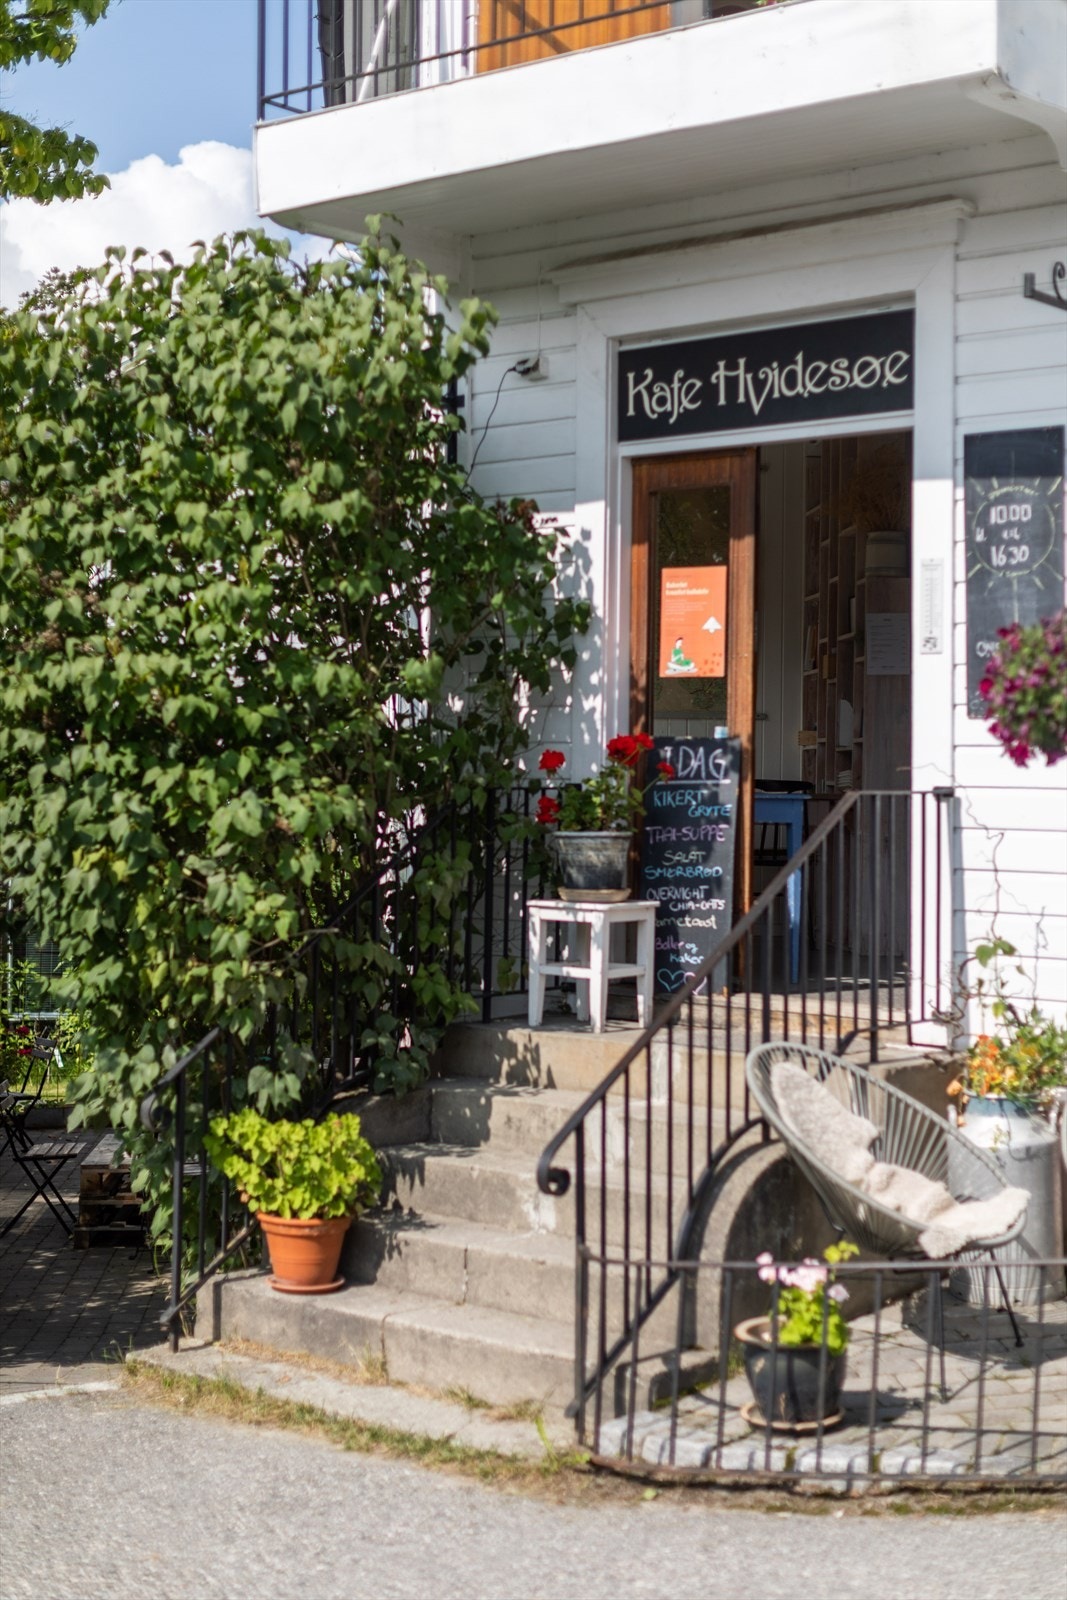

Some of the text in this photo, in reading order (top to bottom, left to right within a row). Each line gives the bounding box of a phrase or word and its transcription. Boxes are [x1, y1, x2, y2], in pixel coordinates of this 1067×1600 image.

[626, 367, 703, 425] Kafe
[678, 745, 727, 780] DAG
[653, 789, 709, 808] KIKERT
[688, 804, 733, 817] GRYTE
[645, 824, 729, 844] THAI-SUPPE
[662, 850, 706, 866] SALAT
[646, 885, 709, 901] OVERNIGHT
